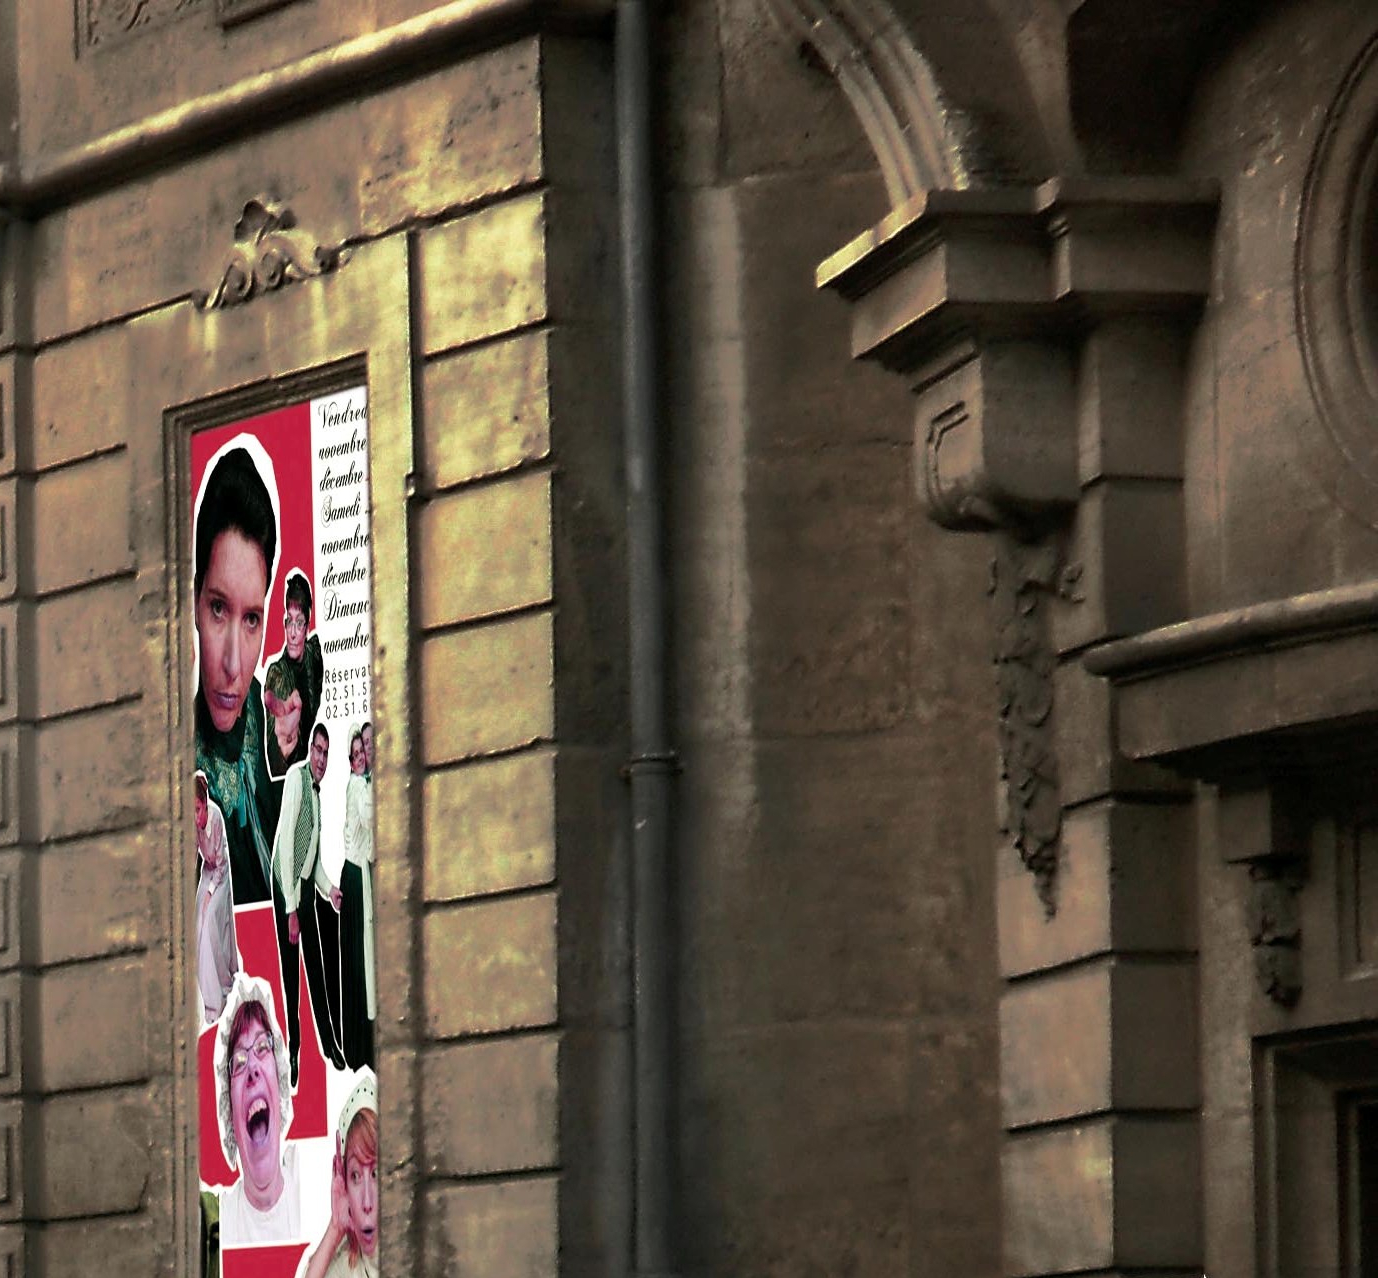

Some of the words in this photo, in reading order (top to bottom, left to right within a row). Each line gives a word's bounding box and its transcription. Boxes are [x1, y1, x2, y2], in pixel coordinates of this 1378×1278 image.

[318, 428, 367, 460] novembre
[319, 460, 363, 492] décembre
[321, 491, 362, 528] Samedi
[321, 523, 370, 556] novembre
[321, 556, 366, 588] décembre
[323, 622, 370, 654] novembre
[325, 681, 367, 702] 02.51.5
[325, 699, 368, 720] 02.51.6
